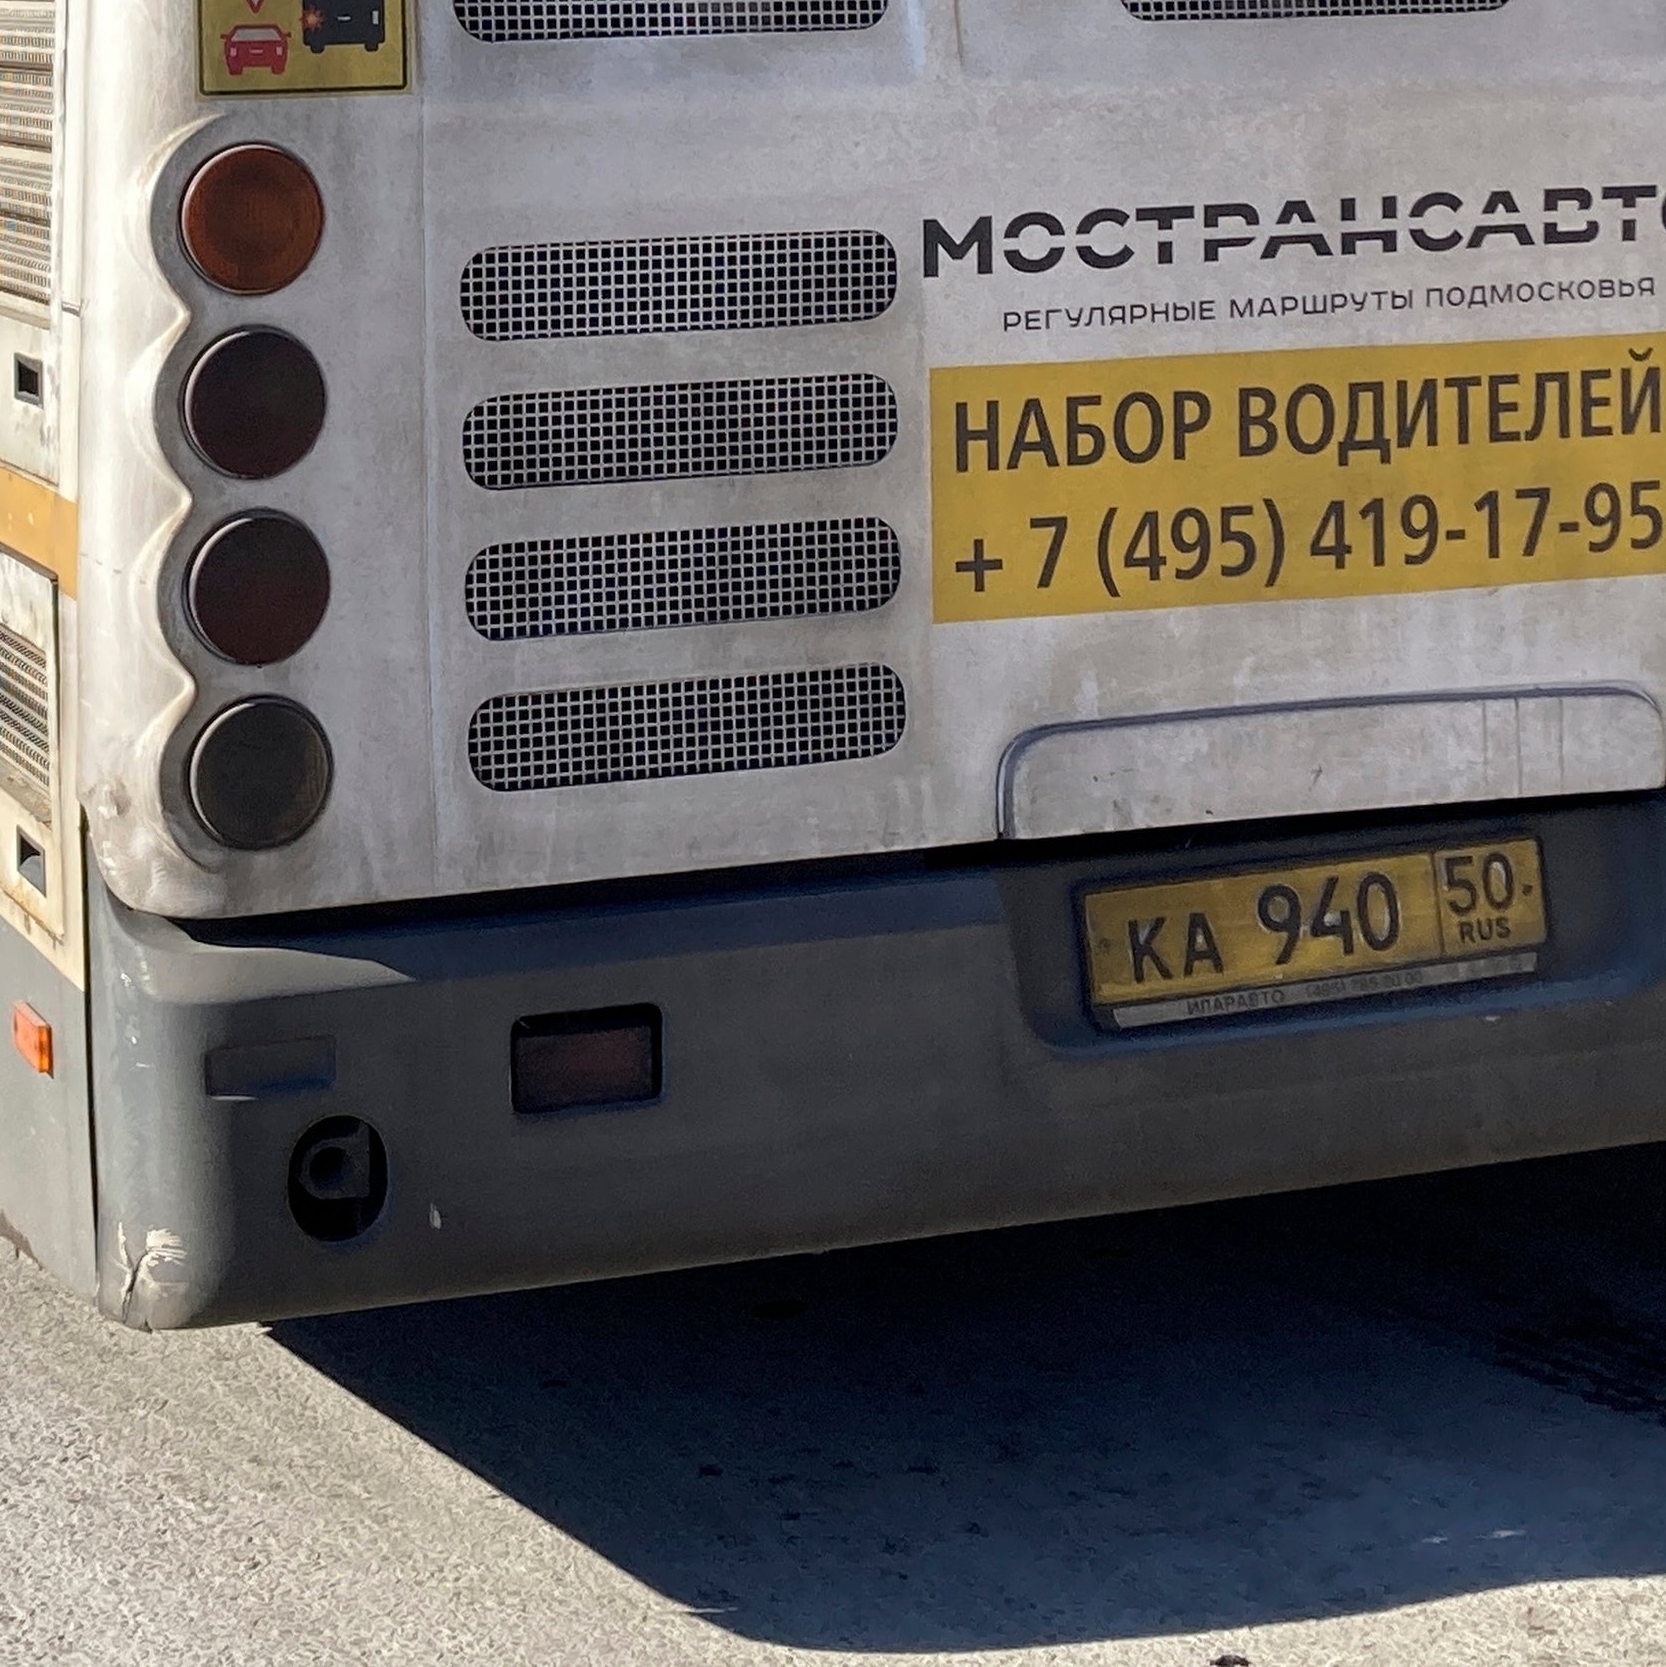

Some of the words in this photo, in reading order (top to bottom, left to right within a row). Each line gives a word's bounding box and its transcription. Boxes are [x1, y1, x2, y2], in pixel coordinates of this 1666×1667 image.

[1002, 299, 1217, 332] РЕГУЛЯРНЫЕ
[1229, 288, 1415, 319] МАРШРУТЫ
[1425, 276, 1656, 309] ПОДМОСКОВЬЯ
[954, 390, 1212, 474] НАБОР
[1236, 347, 1664, 465] ВОДИТЕЛЕЙ
[1096, 498, 1286, 598] (495)
[1310, 479, 1665, 570] 419-17-95
[1256, 870, 1400, 966] 940
[1443, 853, 1514, 917] 50
[1457, 916, 1512, 944] RUS
